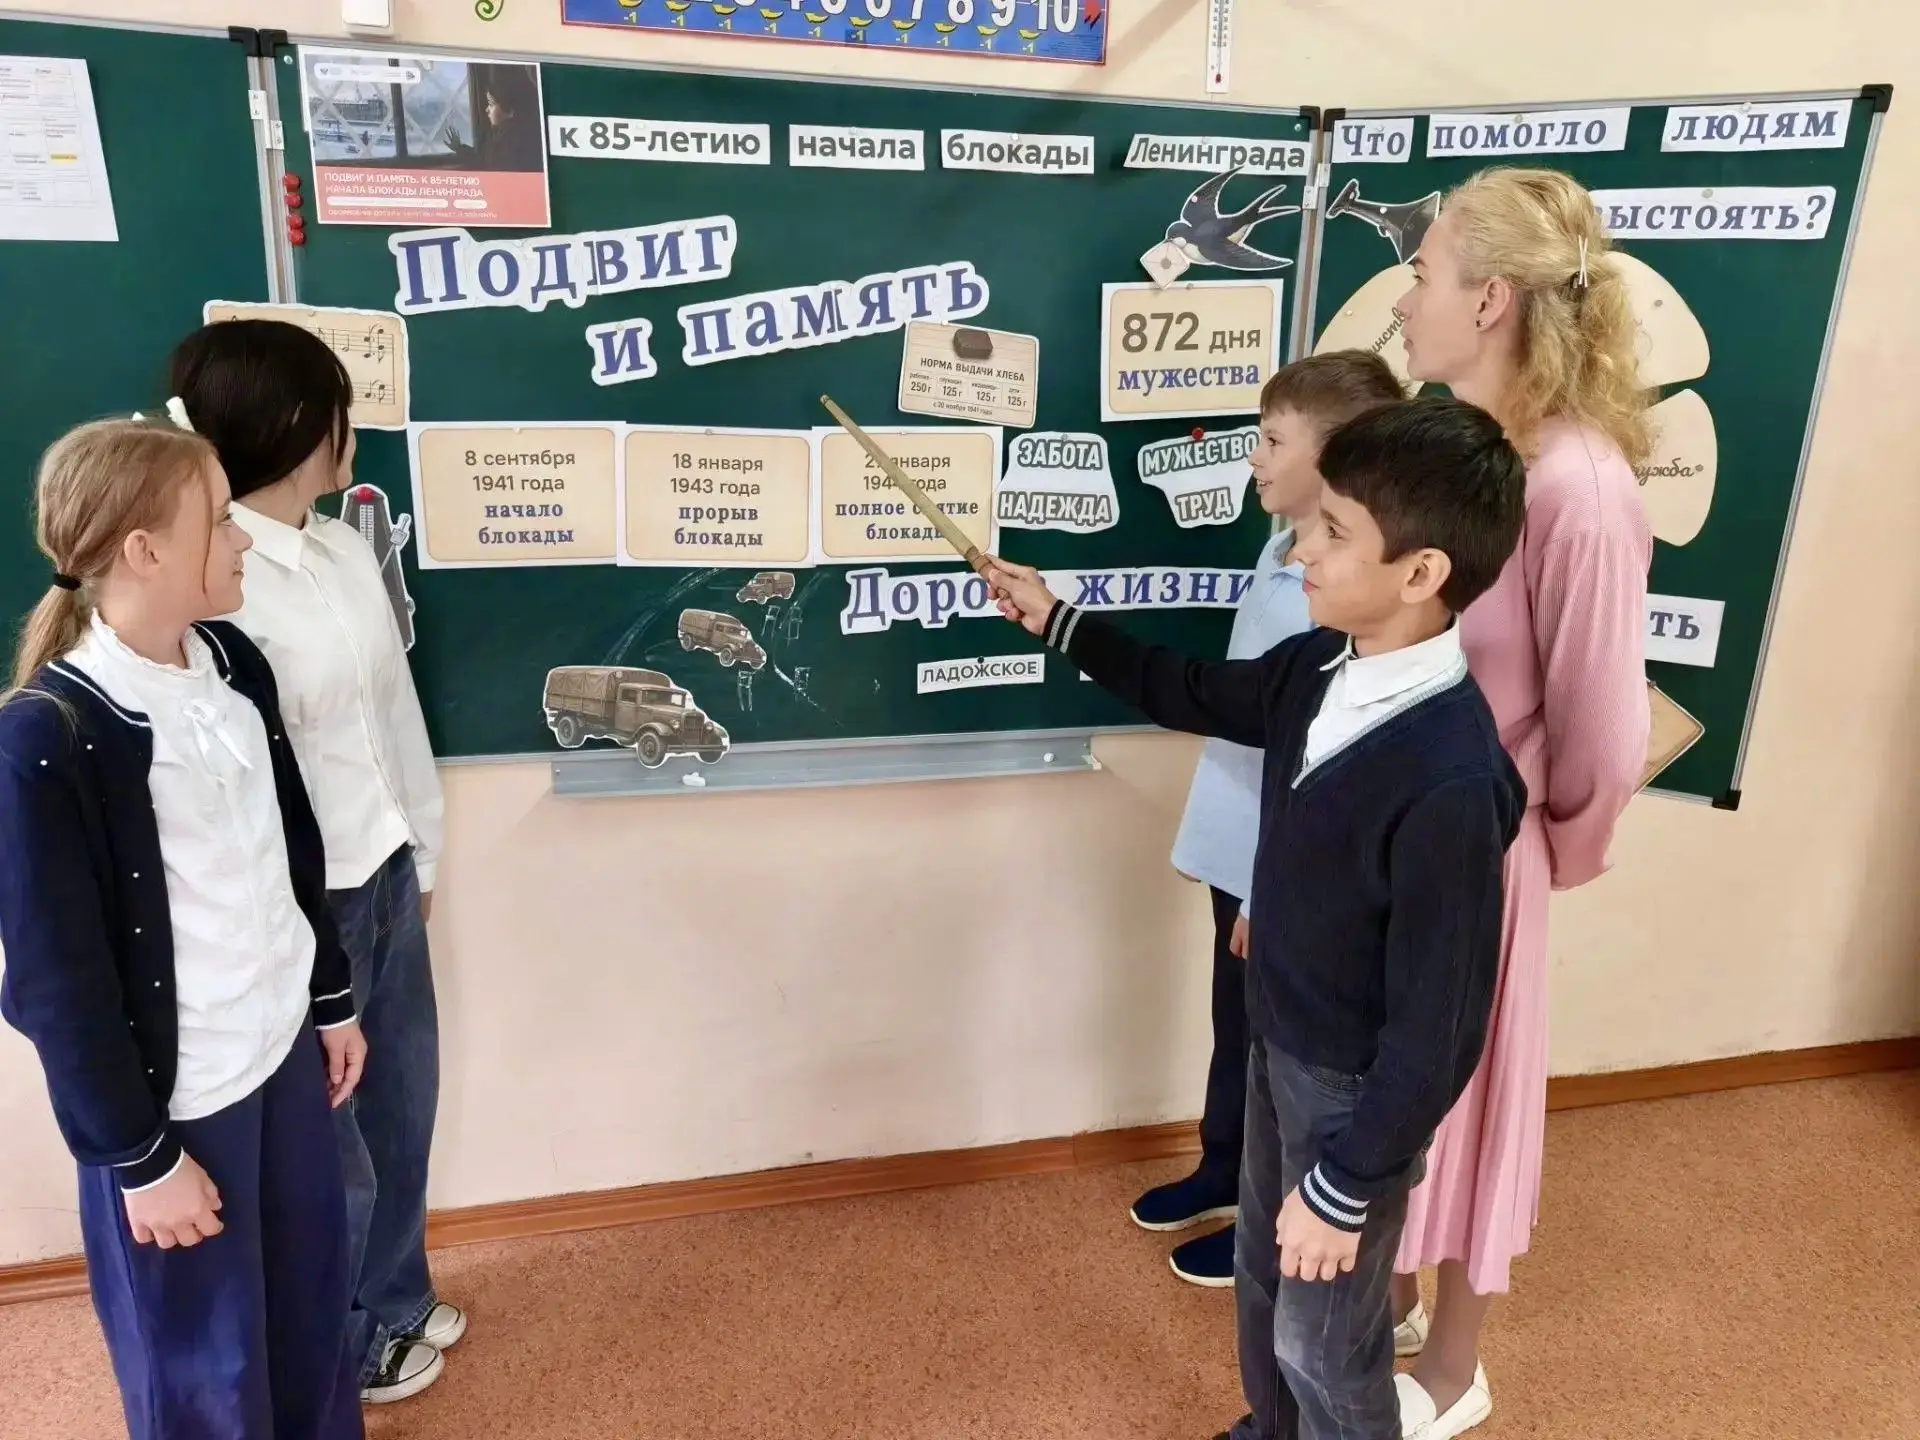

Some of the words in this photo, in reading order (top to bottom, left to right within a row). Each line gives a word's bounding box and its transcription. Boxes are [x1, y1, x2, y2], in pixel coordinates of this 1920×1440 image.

[1031, 0, 1078, 33] 10
[1341, 125, 1405, 156] Что
[1433, 120, 1607, 149] помогло
[1671, 111, 1838, 145] людям
[560, 127, 580, 148] к
[589, 122, 760, 155] 85-летию
[798, 135, 916, 159] начала
[947, 133, 1089, 169] блокады
[1131, 137, 1305, 170] Ленинграда
[324, 172, 364, 183] ПОДВИГ
[367, 174, 374, 183] И
[377, 174, 419, 185] ПАМЯТЬ.
[421, 175, 429, 185] К
[430, 175, 480, 186] 85-ЛЕТИЮ
[326, 185, 366, 195] НАЧАЛА
[368, 186, 417, 197] БЛОКАДЫ
[419, 187, 484, 198] ЛЕНИНГРАДА
[1597, 194, 1827, 230] ыстоять?
[398, 225, 728, 306] Подвиг
[596, 327, 648, 377] и
[686, 268, 983, 358] память
[1122, 312, 1199, 353] 872
[1209, 329, 1261, 354] дня
[920, 358, 952, 371] НОРМА
[956, 363, 993, 376] ВЫДАЧИ
[996, 369, 1025, 382] ХЛЕБА
[1117, 364, 1260, 397] мужества
[911, 381, 927, 393] 250
[943, 385, 957, 397] 125
[976, 391, 991, 402] 125
[1007, 395, 1022, 407] 125
[465, 450, 477, 466] 8
[484, 450, 576, 469] сентября
[672, 453, 692, 469] 18
[698, 457, 763, 474] января
[865, 454, 881, 469] 2
[1017, 438, 1103, 470] ЗАБОТА
[1143, 431, 1260, 477] МУЖЕСТВО
[1634, 457, 1694, 486] ужба
[473, 475, 514, 491] 1941
[521, 477, 565, 493] года
[670, 478, 713, 494] 1943
[720, 482, 761, 497] года
[484, 503, 564, 518] начало
[678, 506, 759, 524] прорыв
[835, 502, 905, 516] полное
[912, 502, 979, 515] сятие
[998, 491, 1112, 527] НАДЕЖДА
[1175, 487, 1235, 522] ТРУД
[479, 526, 574, 545] блокады
[674, 528, 763, 547] блокады
[847, 572, 1046, 628] Доро
[922, 661, 1037, 683] ЛАДОЖСКОЕ
